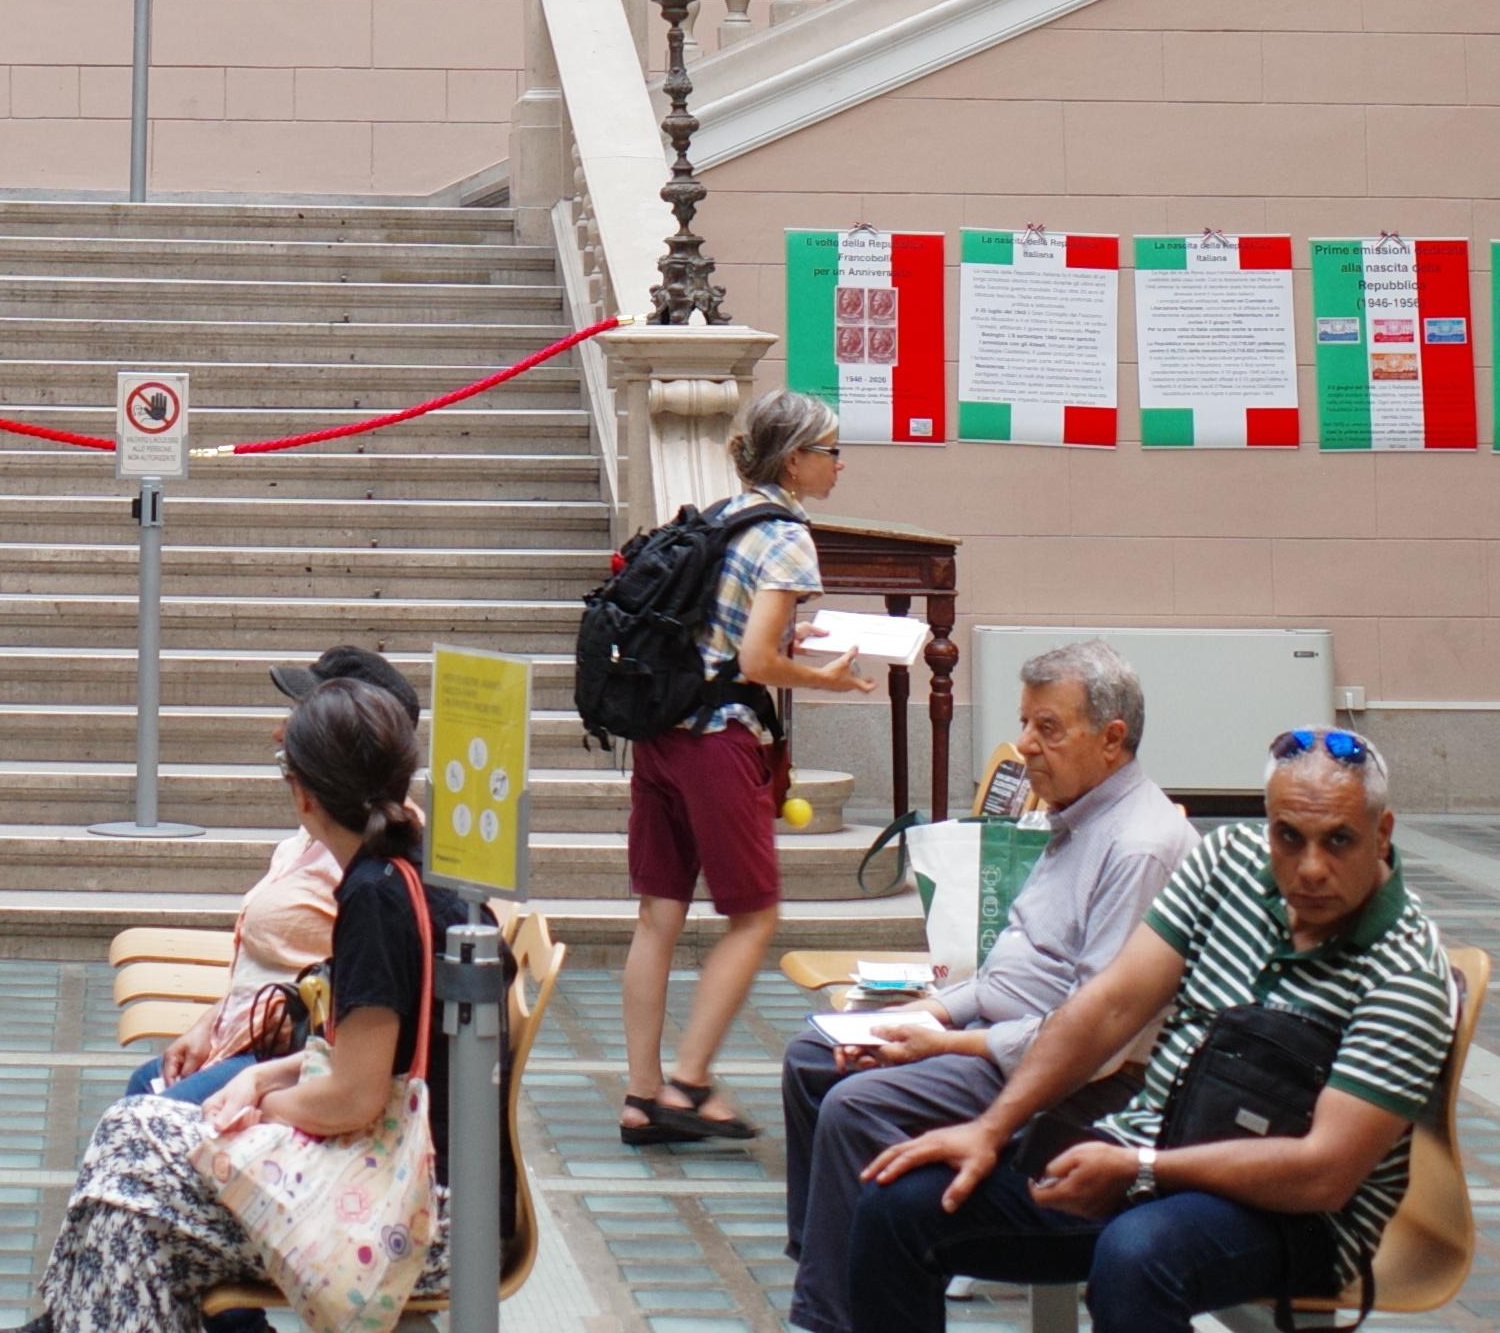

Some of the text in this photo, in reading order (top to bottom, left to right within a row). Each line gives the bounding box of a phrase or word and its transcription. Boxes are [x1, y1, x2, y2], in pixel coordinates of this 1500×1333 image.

[842, 239, 865, 248] della
[982, 236, 992, 244] La
[1155, 241, 1165, 250] La
[1167, 242, 1197, 250] nascita
[1200, 241, 1221, 250] della
[1315, 244, 1350, 255] Prime
[1353, 244, 1411, 256] emissioni
[1023, 250, 1054, 259] Italiana
[1196, 254, 1227, 262] Italiana
[1341, 262, 1362, 273] alla
[1366, 262, 1408, 273] nascita
[814, 268, 829, 277] per
[1358, 280, 1426, 292] Repubblica
[1356, 297, 1426, 311] (1946-1956)
